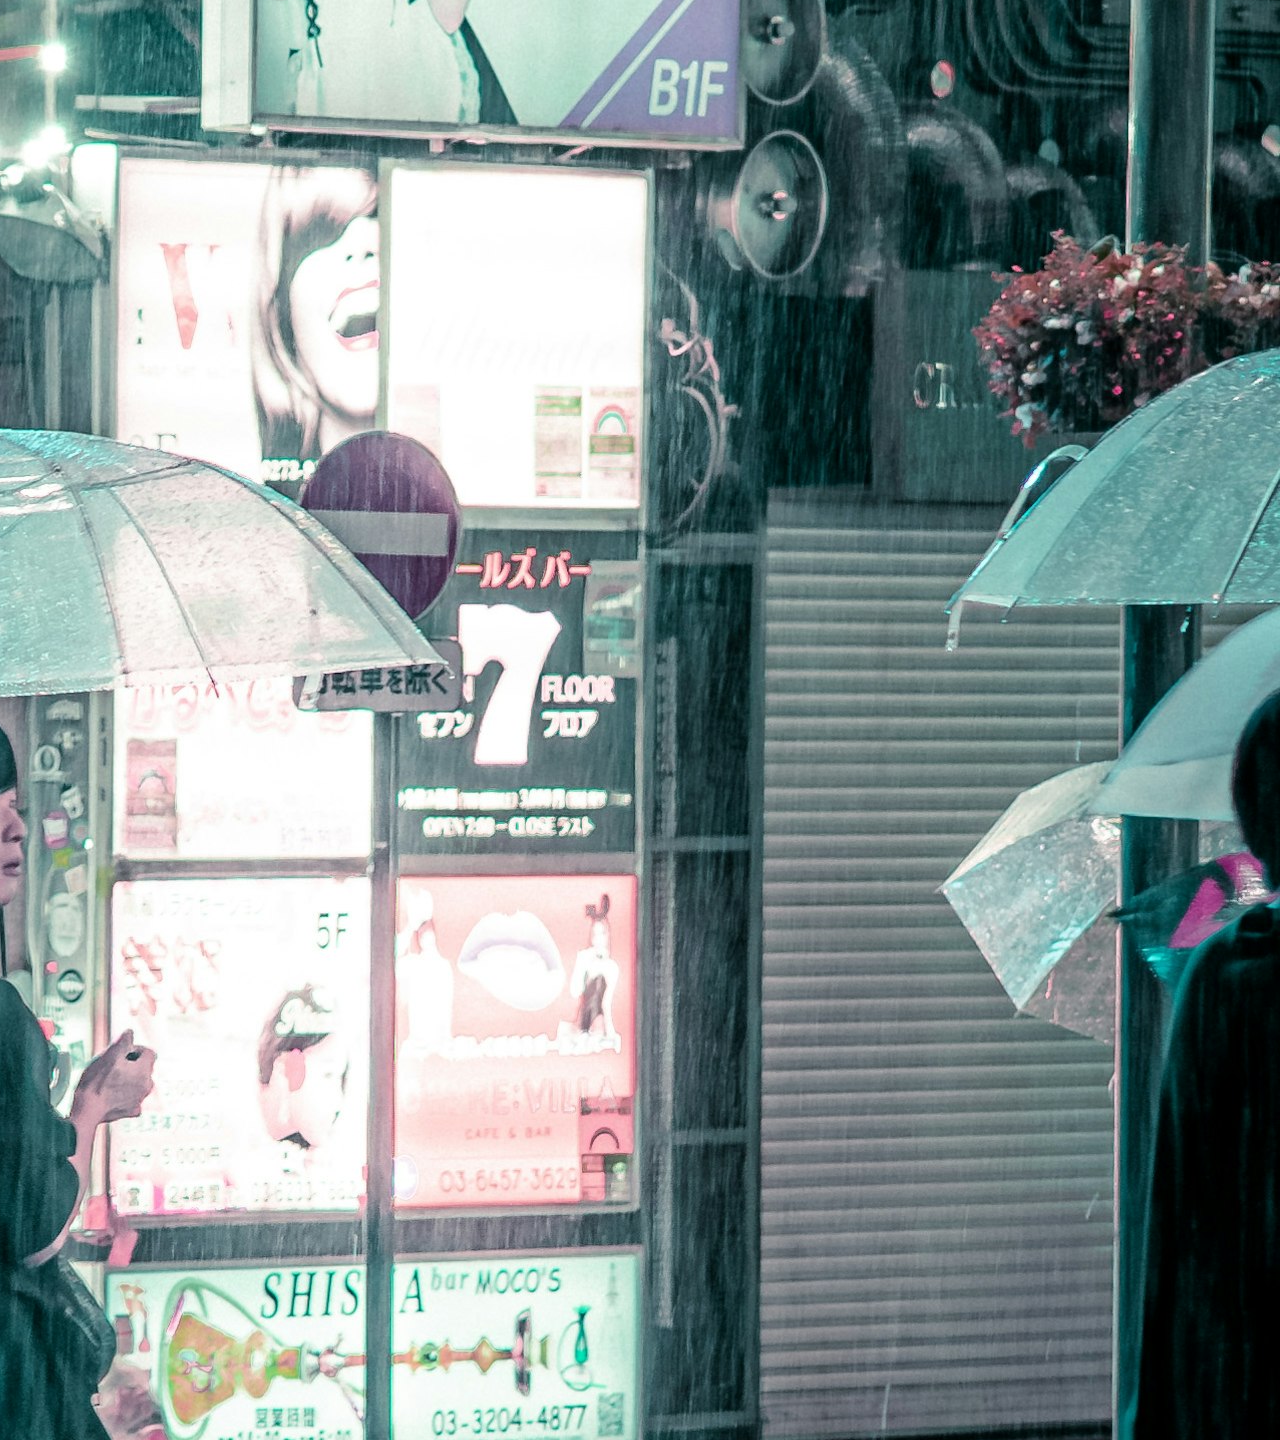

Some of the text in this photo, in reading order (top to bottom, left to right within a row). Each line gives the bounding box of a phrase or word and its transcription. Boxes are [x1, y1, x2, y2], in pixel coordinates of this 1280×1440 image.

[648, 58, 728, 118] B1F
[320, 665, 449, 697] 転車を除く
[458, 603, 563, 766] 7
[541, 675, 616, 703] FLOOR
[541, 711, 600, 738] フロア
[317, 912, 349, 950] 5F
[465, 1126, 499, 1141] CAFE
[525, 1125, 553, 1139] BAR
[440, 1167, 578, 1195] 03-6457-3629
[260, 1261, 562, 1319] SHISA bar MOCO'S
[433, 1404, 588, 1436] 03-3204-4877
